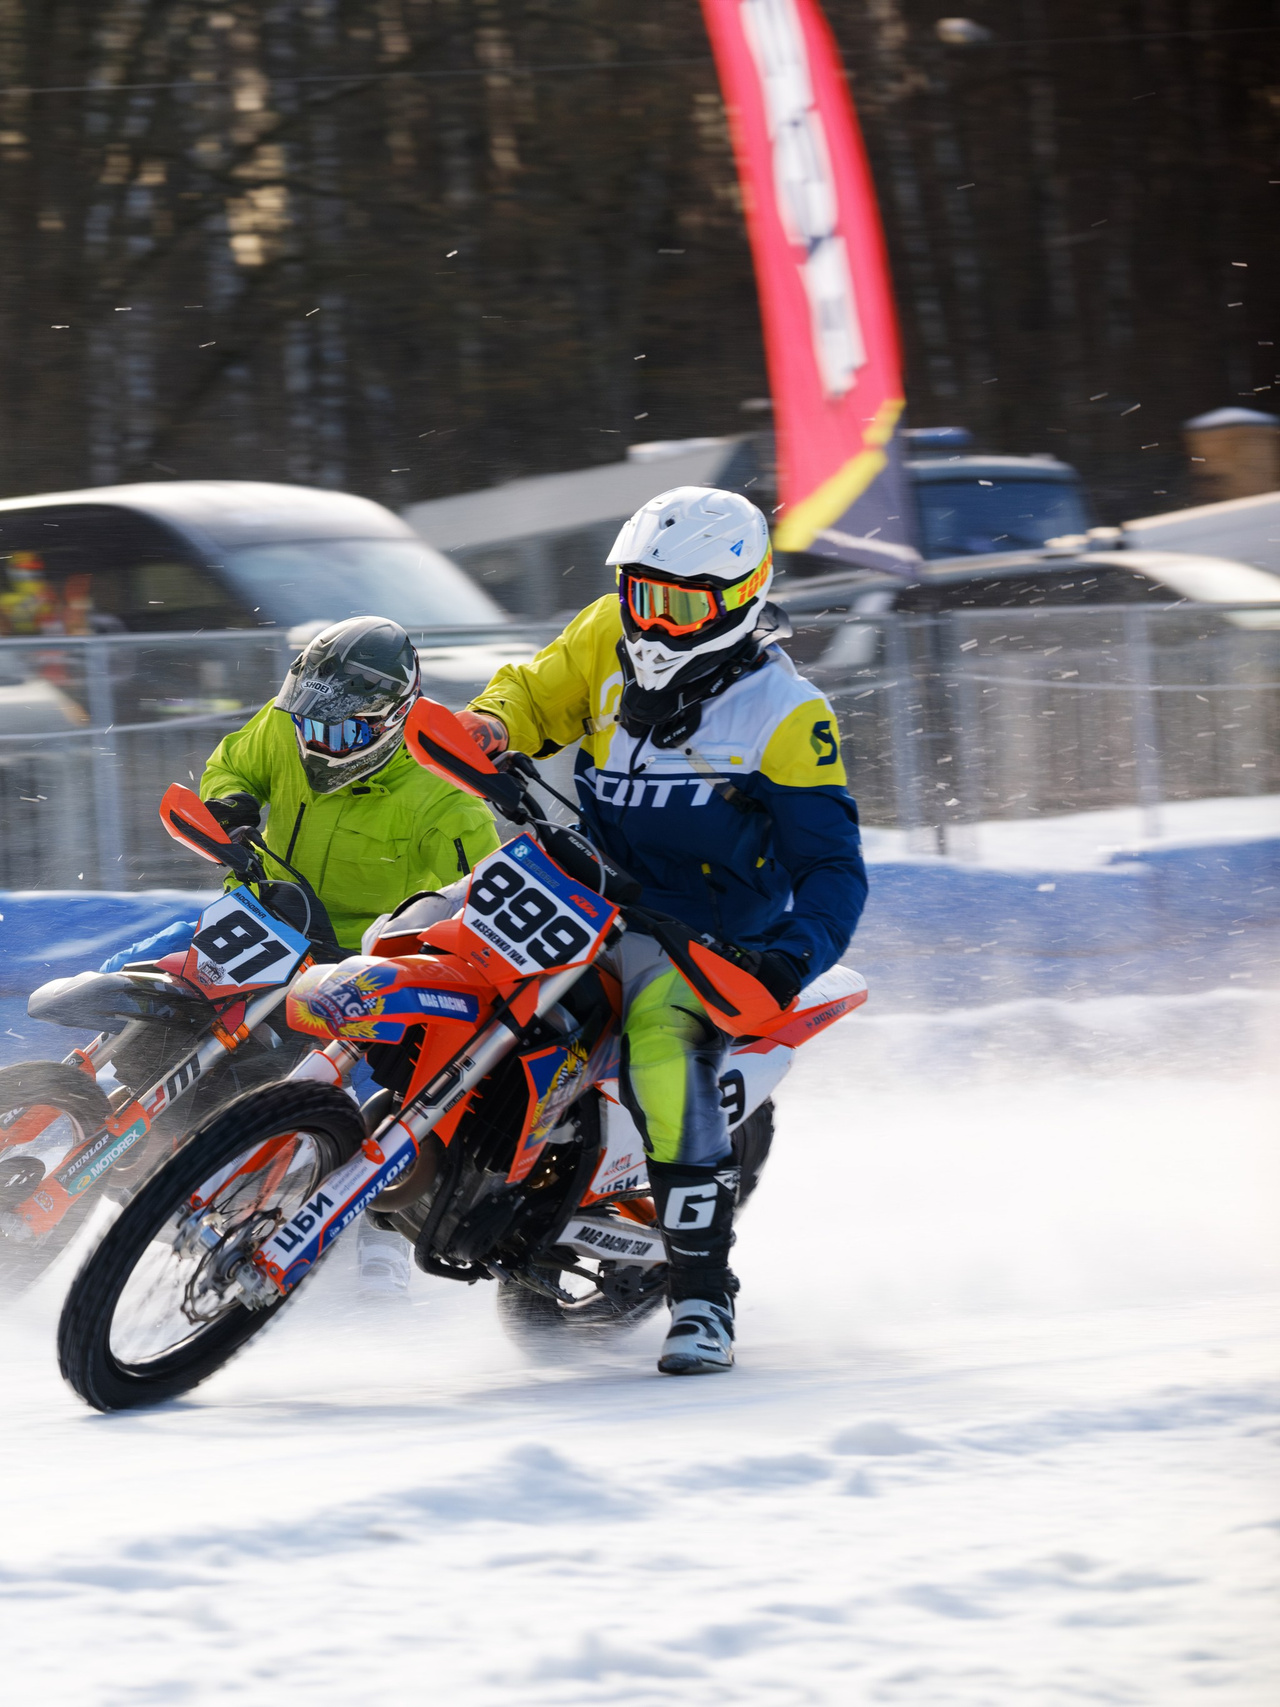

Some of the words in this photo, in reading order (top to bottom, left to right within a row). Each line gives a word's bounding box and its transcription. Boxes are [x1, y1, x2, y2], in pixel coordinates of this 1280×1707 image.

[737, 551, 773, 605] 100
[303, 681, 330, 694] SHOEI
[467, 861, 591, 969] 899
[569, 894, 599, 919] KTM
[191, 910, 291, 985] 81
[471, 919, 511, 953] AKSENENKO
[508, 946, 528, 967] IVAN
[418, 993, 438, 1009] MAG
[439, 995, 468, 1013] RACING
[812, 1001, 847, 1026] DUNLOP
[67, 1133, 110, 1178] DUNLOP
[90, 1128, 140, 1178] MOTOREX
[341, 1153, 410, 1227] DUNLOP
[273, 1191, 334, 1253] ЦБИ
[574, 1226, 601, 1242] MAG
[601, 1230, 633, 1251] RACING
[633, 1239, 653, 1256] TEAM
